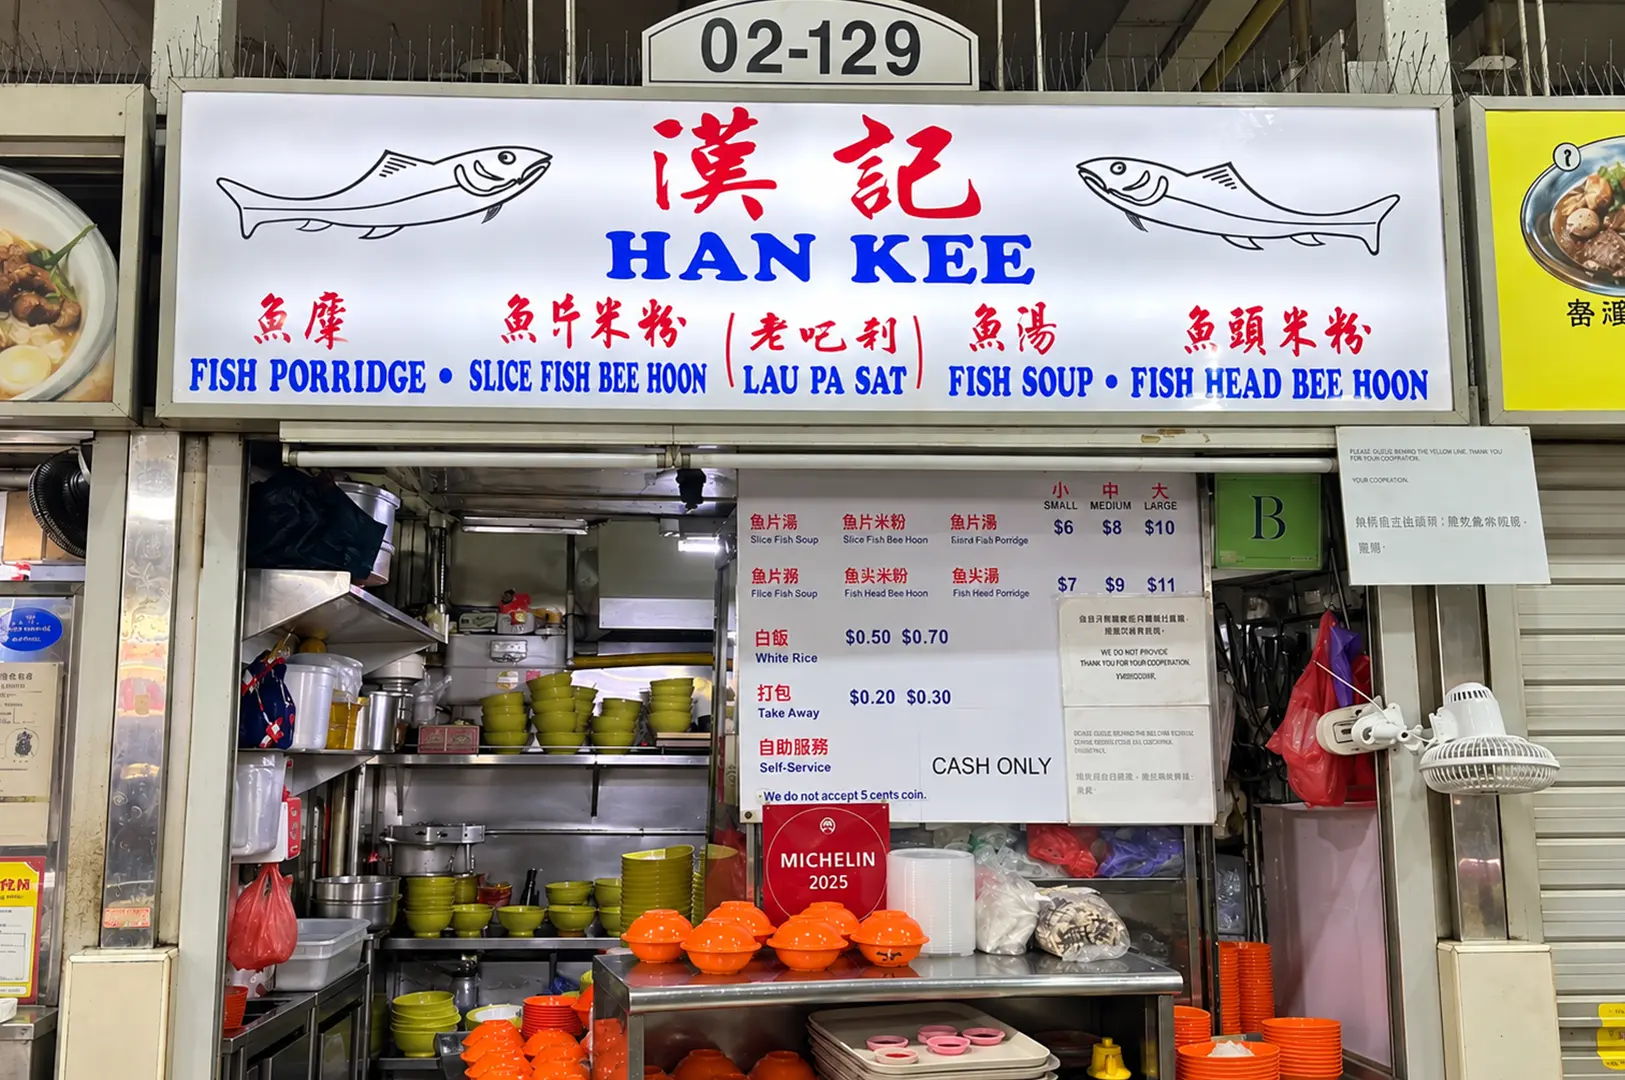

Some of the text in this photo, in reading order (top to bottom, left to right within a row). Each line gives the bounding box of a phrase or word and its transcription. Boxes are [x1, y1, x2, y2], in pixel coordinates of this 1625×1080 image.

[700, 17, 921, 77] 02-129
[653, 106, 982, 222] 漢記
[606, 231, 1035, 285] HAN KEE
[501, 293, 687, 349] 魚片米粉
[969, 302, 1057, 355] 魚湯
[189, 358, 426, 394] FISH PORRIDGE
[469, 359, 708, 395] SLICE FISH BEE HOON
[743, 365, 907, 395] LAU PA SAT
[949, 366, 1093, 397] FISH SOUP
[1131, 367, 1428, 402] FISH HEAD BEE HOON
[1052, 481, 1169, 499] 小 中 大
[1044, 500, 1177, 510] SMALL MEDIUM LARGE
[1249, 495, 1287, 540] B
[1053, 519, 1175, 536] $6 $8 $10
[774, 535, 794, 546] Fish
[795, 535, 819, 546] Soup
[866, 535, 886, 545] Fish
[887, 535, 904, 545] Bee
[905, 535, 929, 545] Hoon
[995, 535, 1029, 547] Porridge
[844, 588, 929, 598] Fish Head Bee Hoon
[1058, 576, 1175, 593] $7 $9 $11
[774, 588, 793, 599] Fish
[795, 588, 818, 599] Soup
[953, 588, 971, 599] Fish
[995, 588, 1030, 599] Porridge
[756, 629, 789, 647] 白飯
[845, 628, 950, 645] $0.50 $0.70
[755, 652, 818, 664] White Rice
[1101, 648, 1112, 656] WE
[1125, 648, 1139, 656] NOT
[757, 684, 792, 702] 打包
[849, 688, 952, 705] $0.20 $0.30
[758, 708, 820, 720] Take Away
[759, 738, 829, 756] 自助服務
[760, 762, 831, 774] Self-Service
[932, 757, 1052, 775] CASH ONLY
[764, 790, 927, 803] We do not accept 5 cents coin.
[781, 852, 876, 868] MICHELIN
[809, 875, 848, 890] 2025
